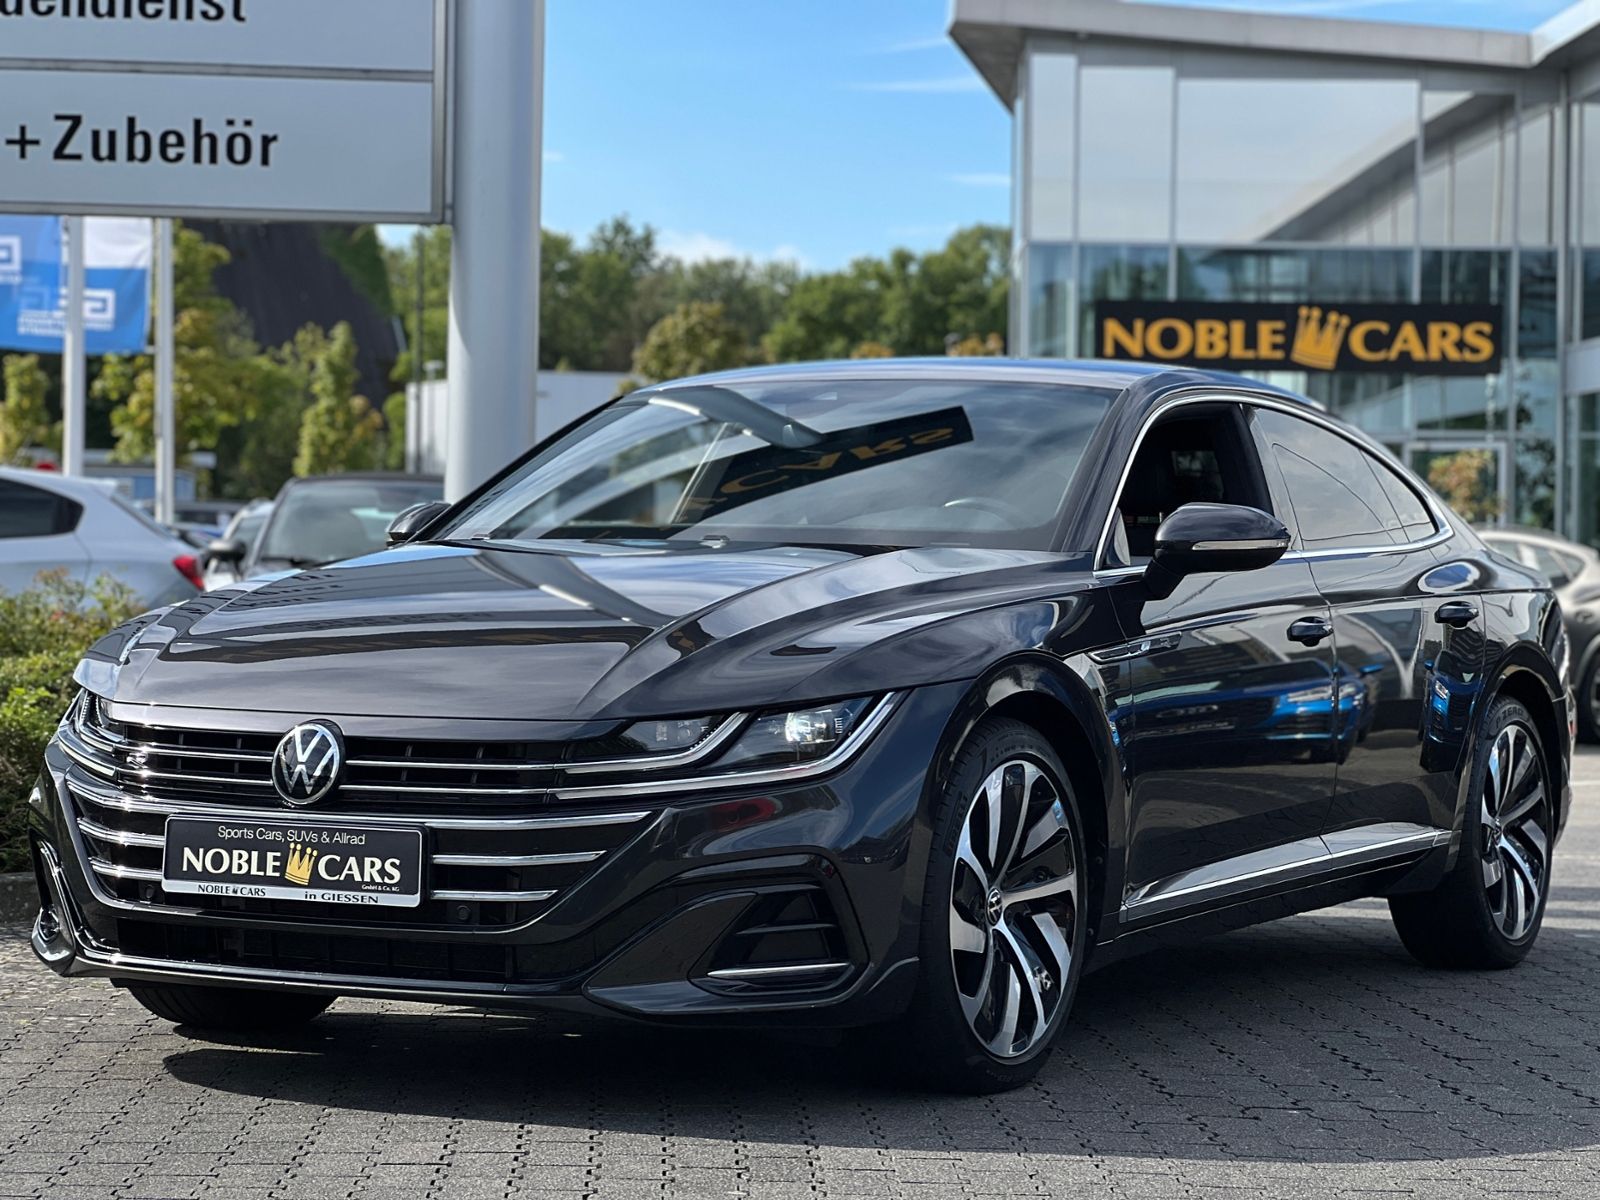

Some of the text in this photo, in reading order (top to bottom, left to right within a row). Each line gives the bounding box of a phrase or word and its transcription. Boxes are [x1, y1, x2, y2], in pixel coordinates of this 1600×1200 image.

[1103, 317, 1494, 363] NOBLE CARS
[217, 825, 366, 845] Sports Cars, SUVs & Allrad
[182, 846, 401, 884] NOBLE CARS
[197, 884, 266, 897] NOBLE CARS
[304, 890, 379, 904] in GIESSEN
